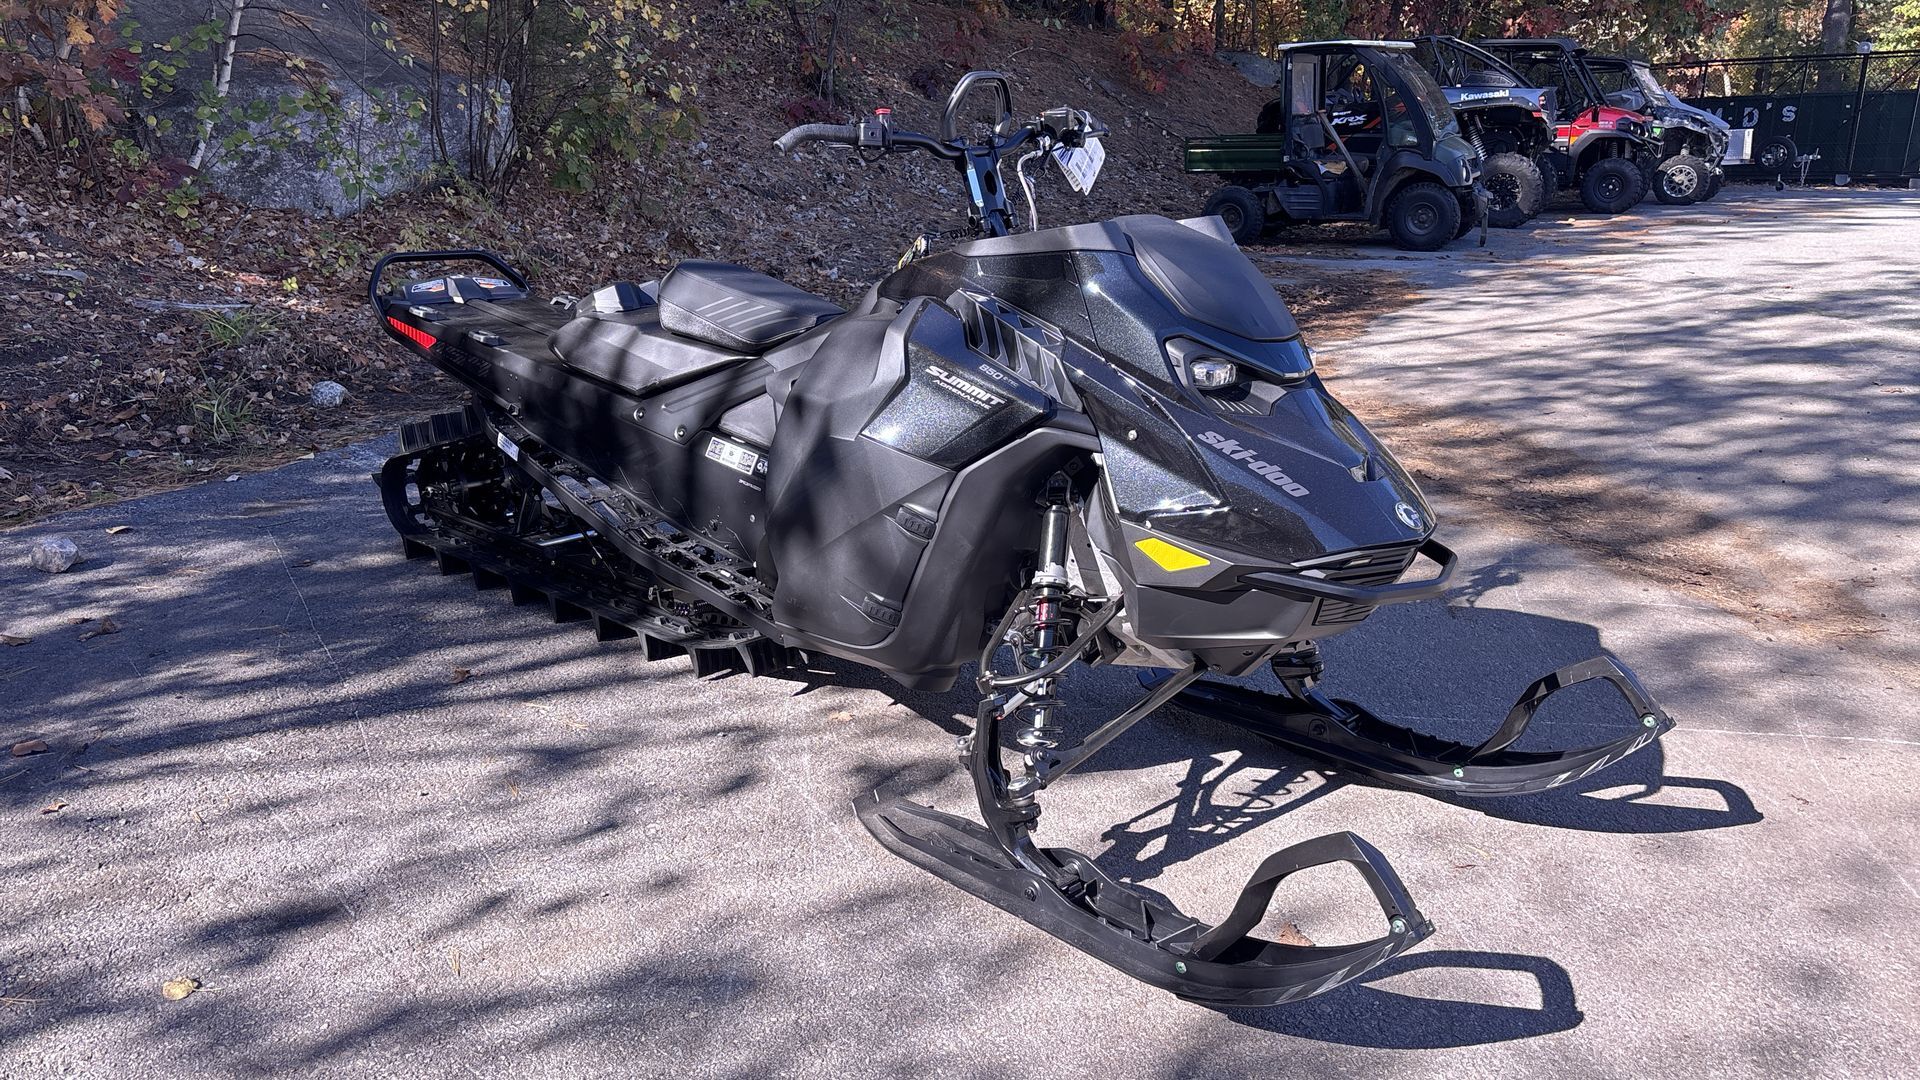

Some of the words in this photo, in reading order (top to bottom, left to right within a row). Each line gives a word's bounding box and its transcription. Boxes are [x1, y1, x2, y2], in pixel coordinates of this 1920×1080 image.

[1460, 89, 1510, 101] Kawasaki
[979, 363, 1004, 380] 850
[925, 365, 1006, 405] SUMMIT
[932, 379, 992, 410] ADRENALINE
